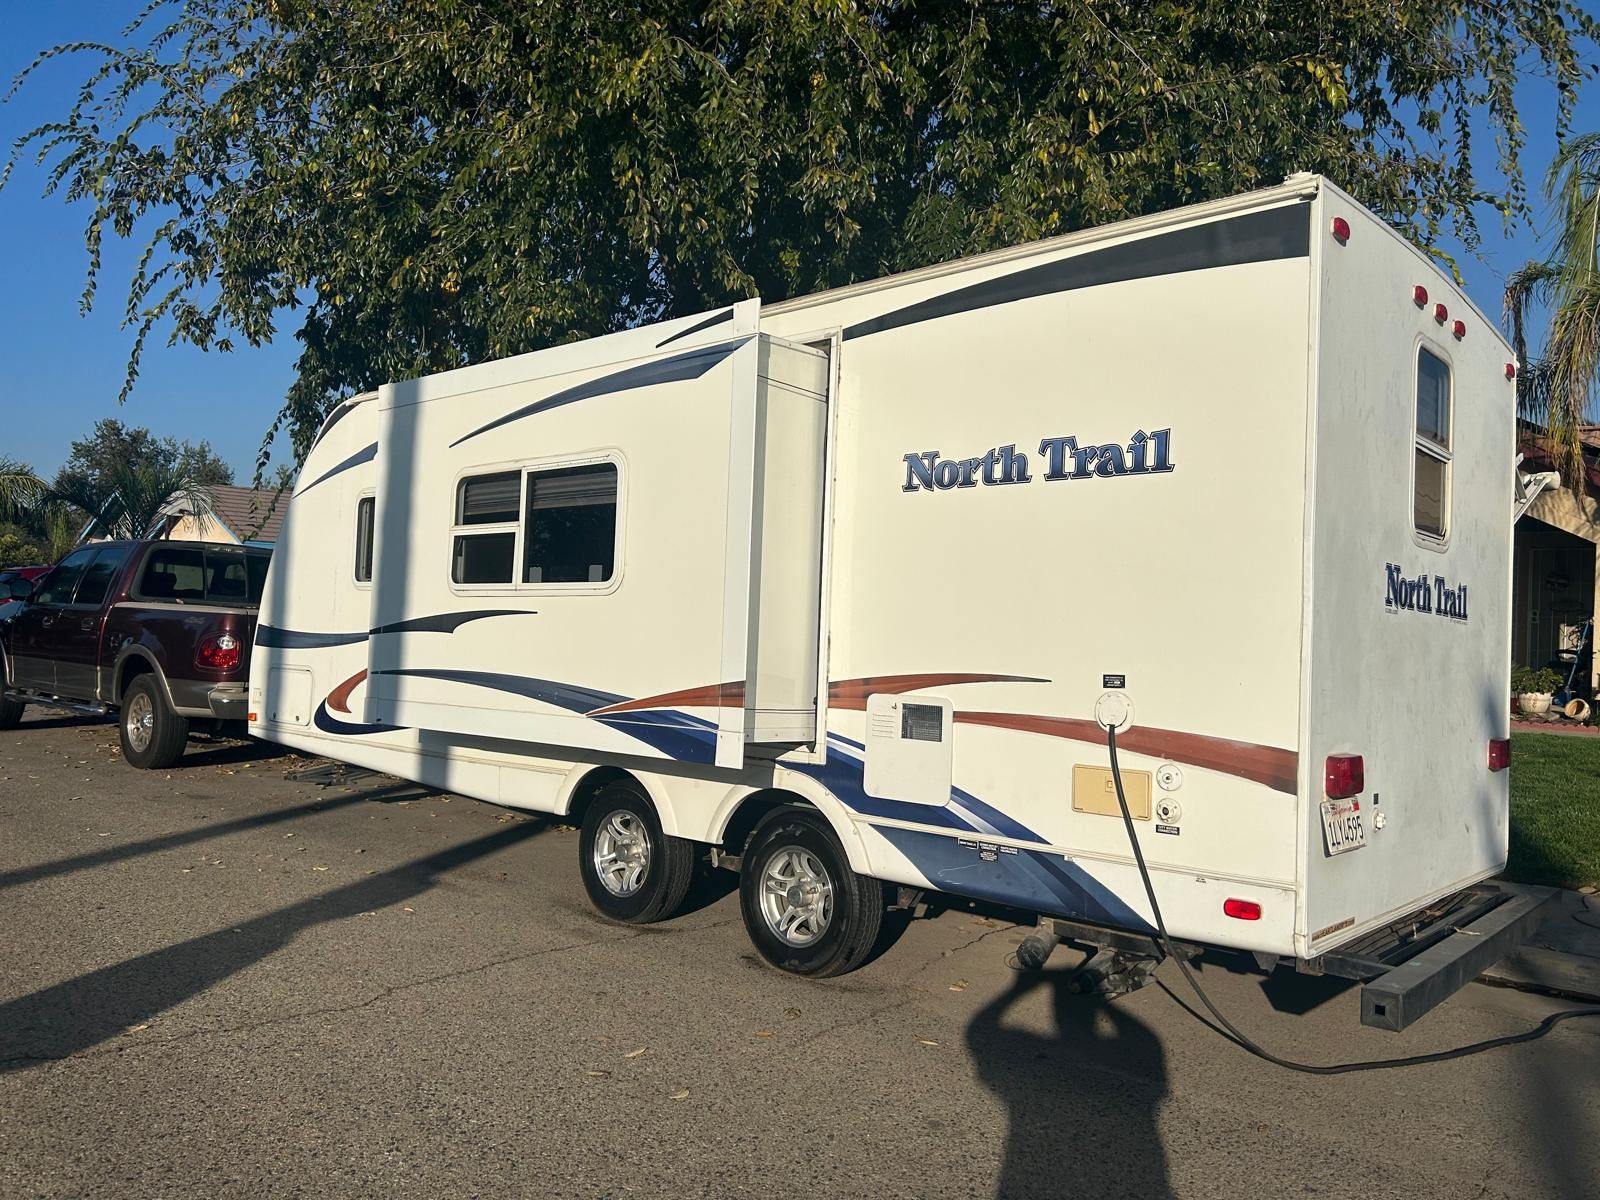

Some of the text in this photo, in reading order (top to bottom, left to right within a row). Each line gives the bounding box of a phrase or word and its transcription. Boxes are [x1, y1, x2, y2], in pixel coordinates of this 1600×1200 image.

[902, 428, 1175, 492] North Trail
[1385, 562, 1468, 620] North Trail
